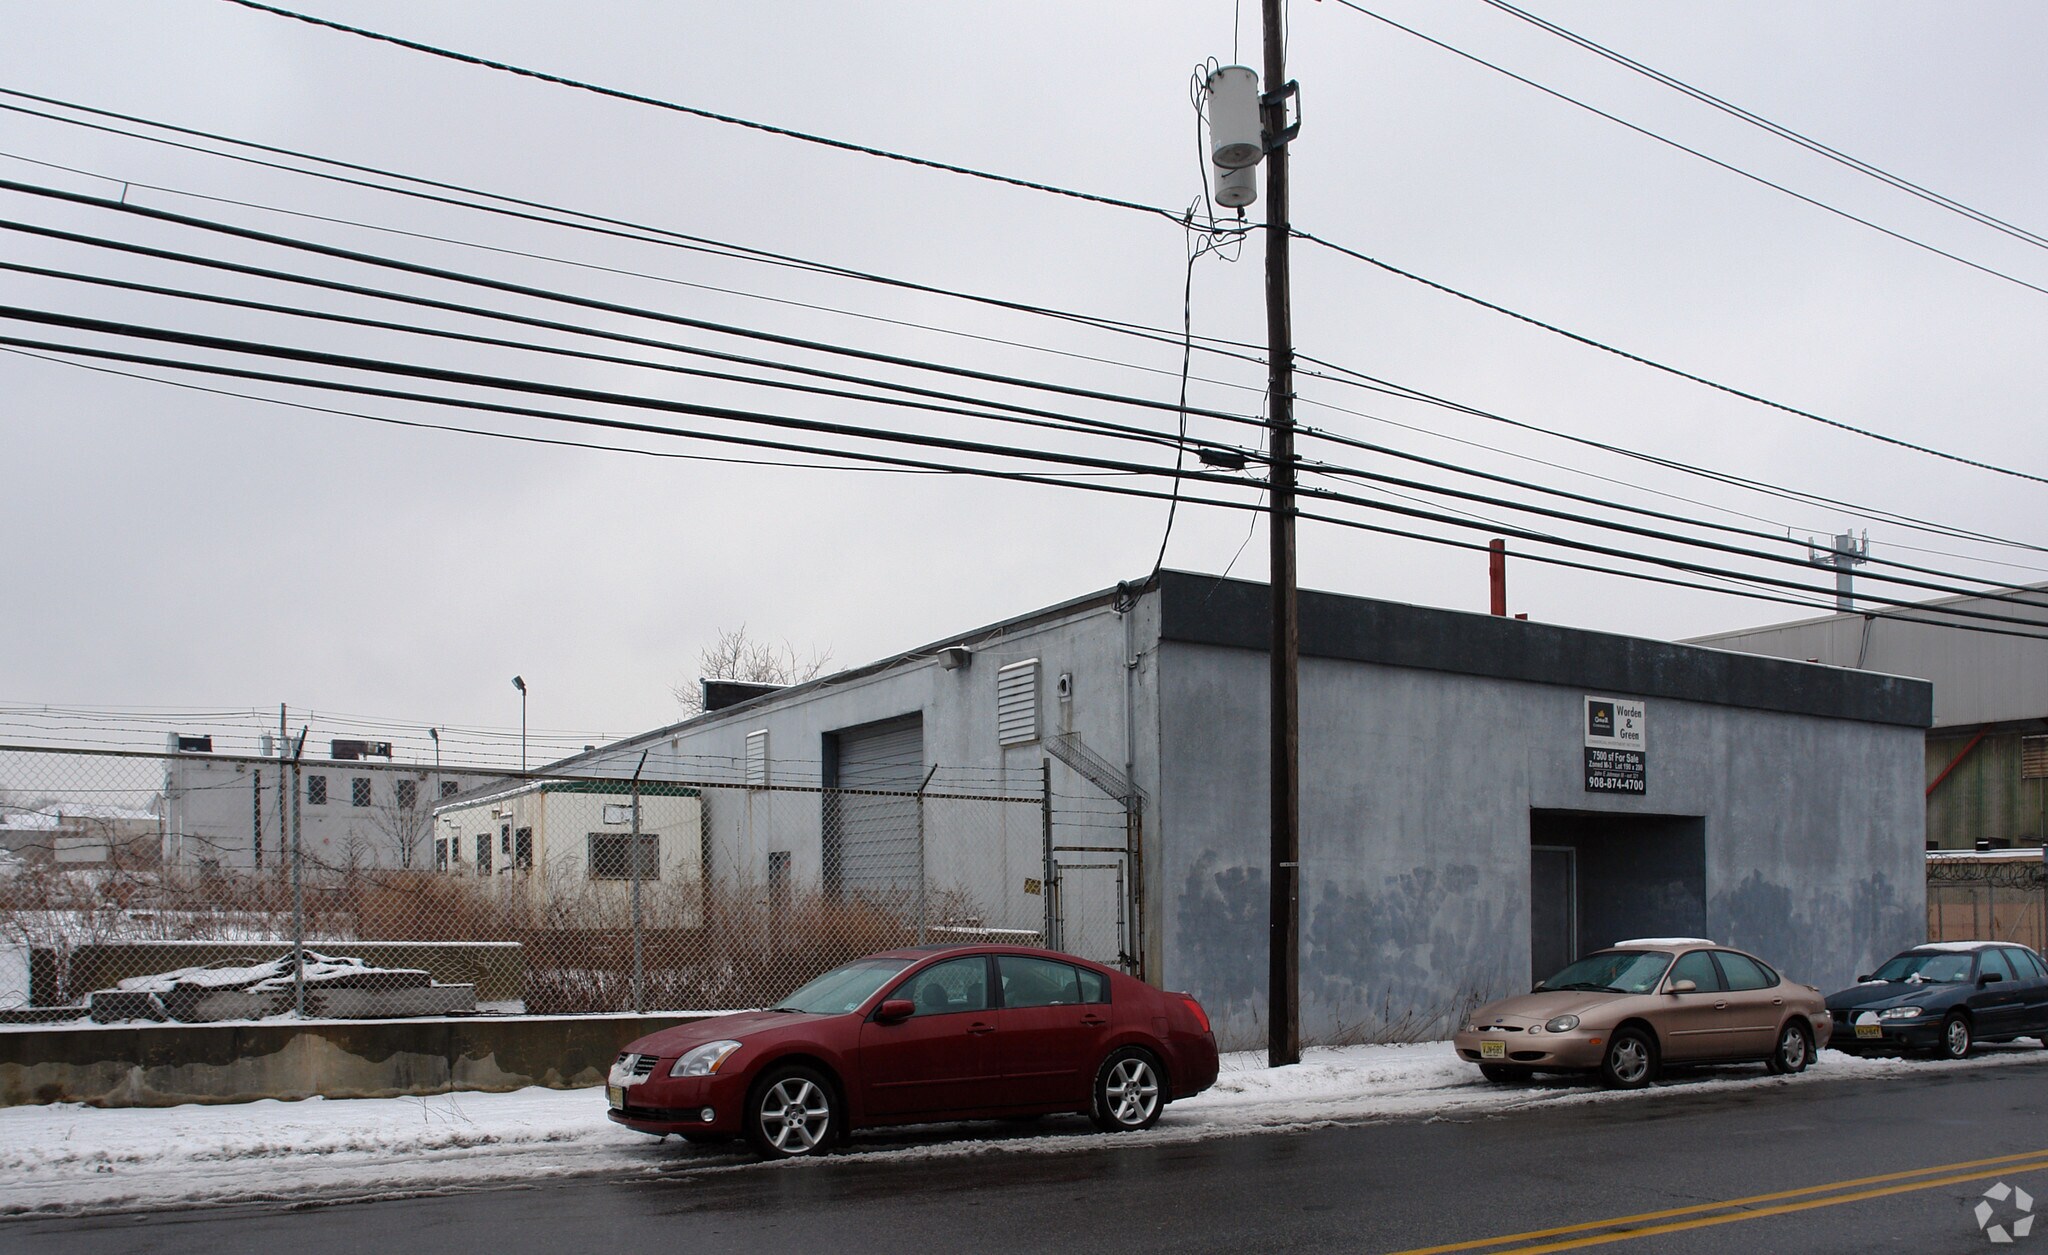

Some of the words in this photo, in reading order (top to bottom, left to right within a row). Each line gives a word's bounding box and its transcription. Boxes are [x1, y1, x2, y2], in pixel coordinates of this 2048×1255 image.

[1626, 718, 1632, 728] &
[1620, 728, 1639, 740] Green
[1593, 750, 1607, 760] 7500
[1608, 752, 1614, 761] sf
[1614, 752, 1625, 762] For
[1626, 753, 1639, 763] Sale
[1589, 777, 1643, 790] 908-874-4700
